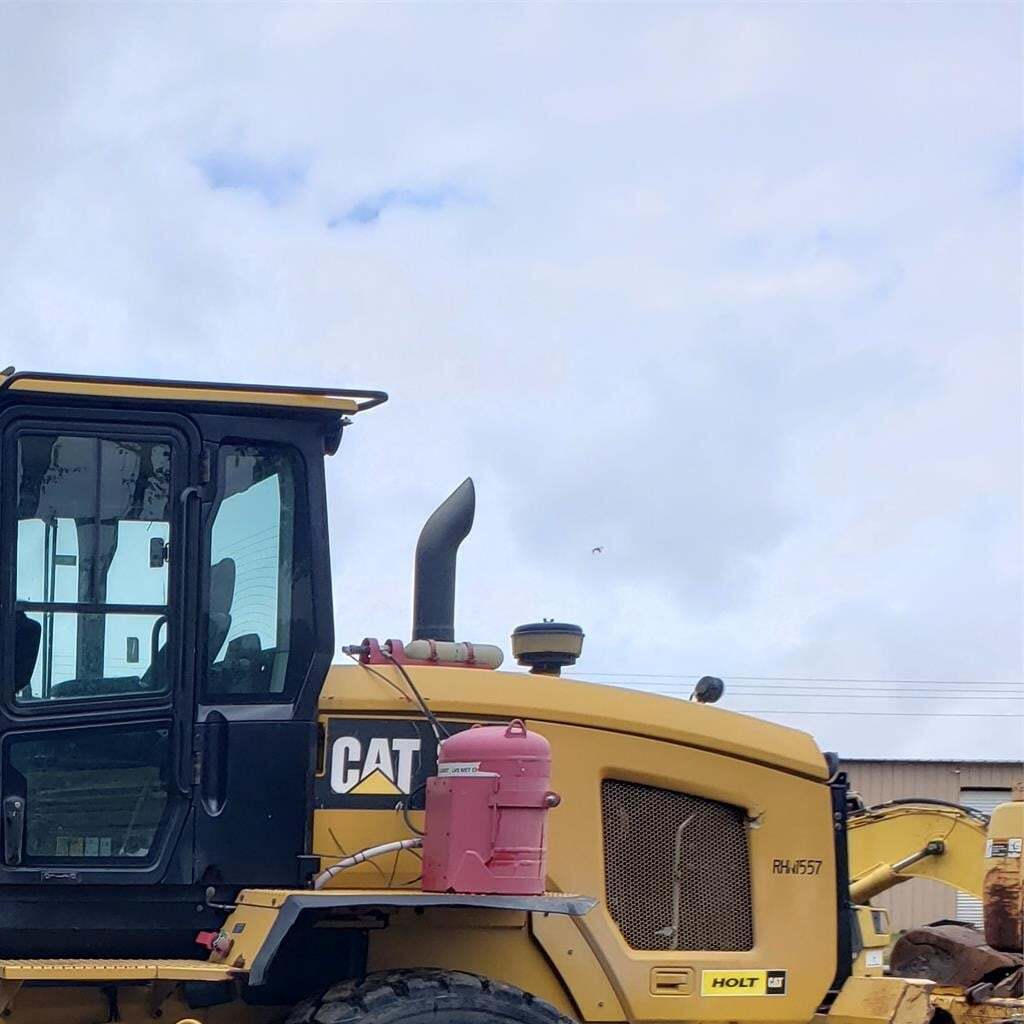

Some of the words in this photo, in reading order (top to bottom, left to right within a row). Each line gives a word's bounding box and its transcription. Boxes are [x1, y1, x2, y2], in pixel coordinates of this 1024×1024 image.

[330, 734, 422, 795] CAT
[711, 976, 760, 989] HOLT
[767, 976, 785, 989] CAT
